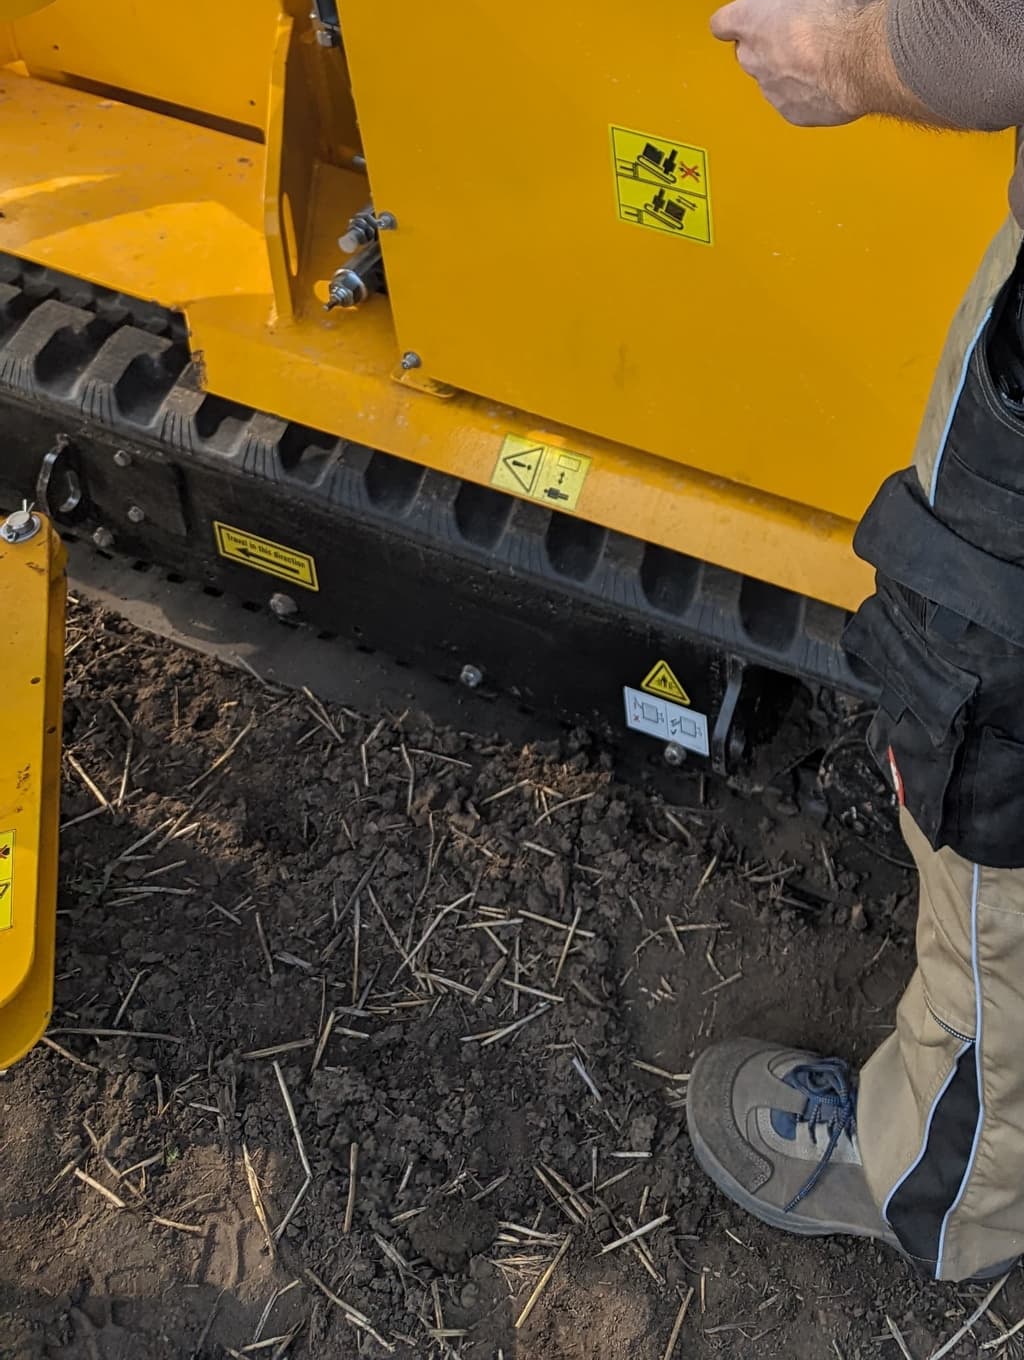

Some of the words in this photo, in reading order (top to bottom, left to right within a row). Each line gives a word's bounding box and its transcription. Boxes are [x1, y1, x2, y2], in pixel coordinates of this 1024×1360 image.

[226, 533, 248, 547] Travel
[249, 542, 257, 550] in
[258, 545, 272, 555] this
